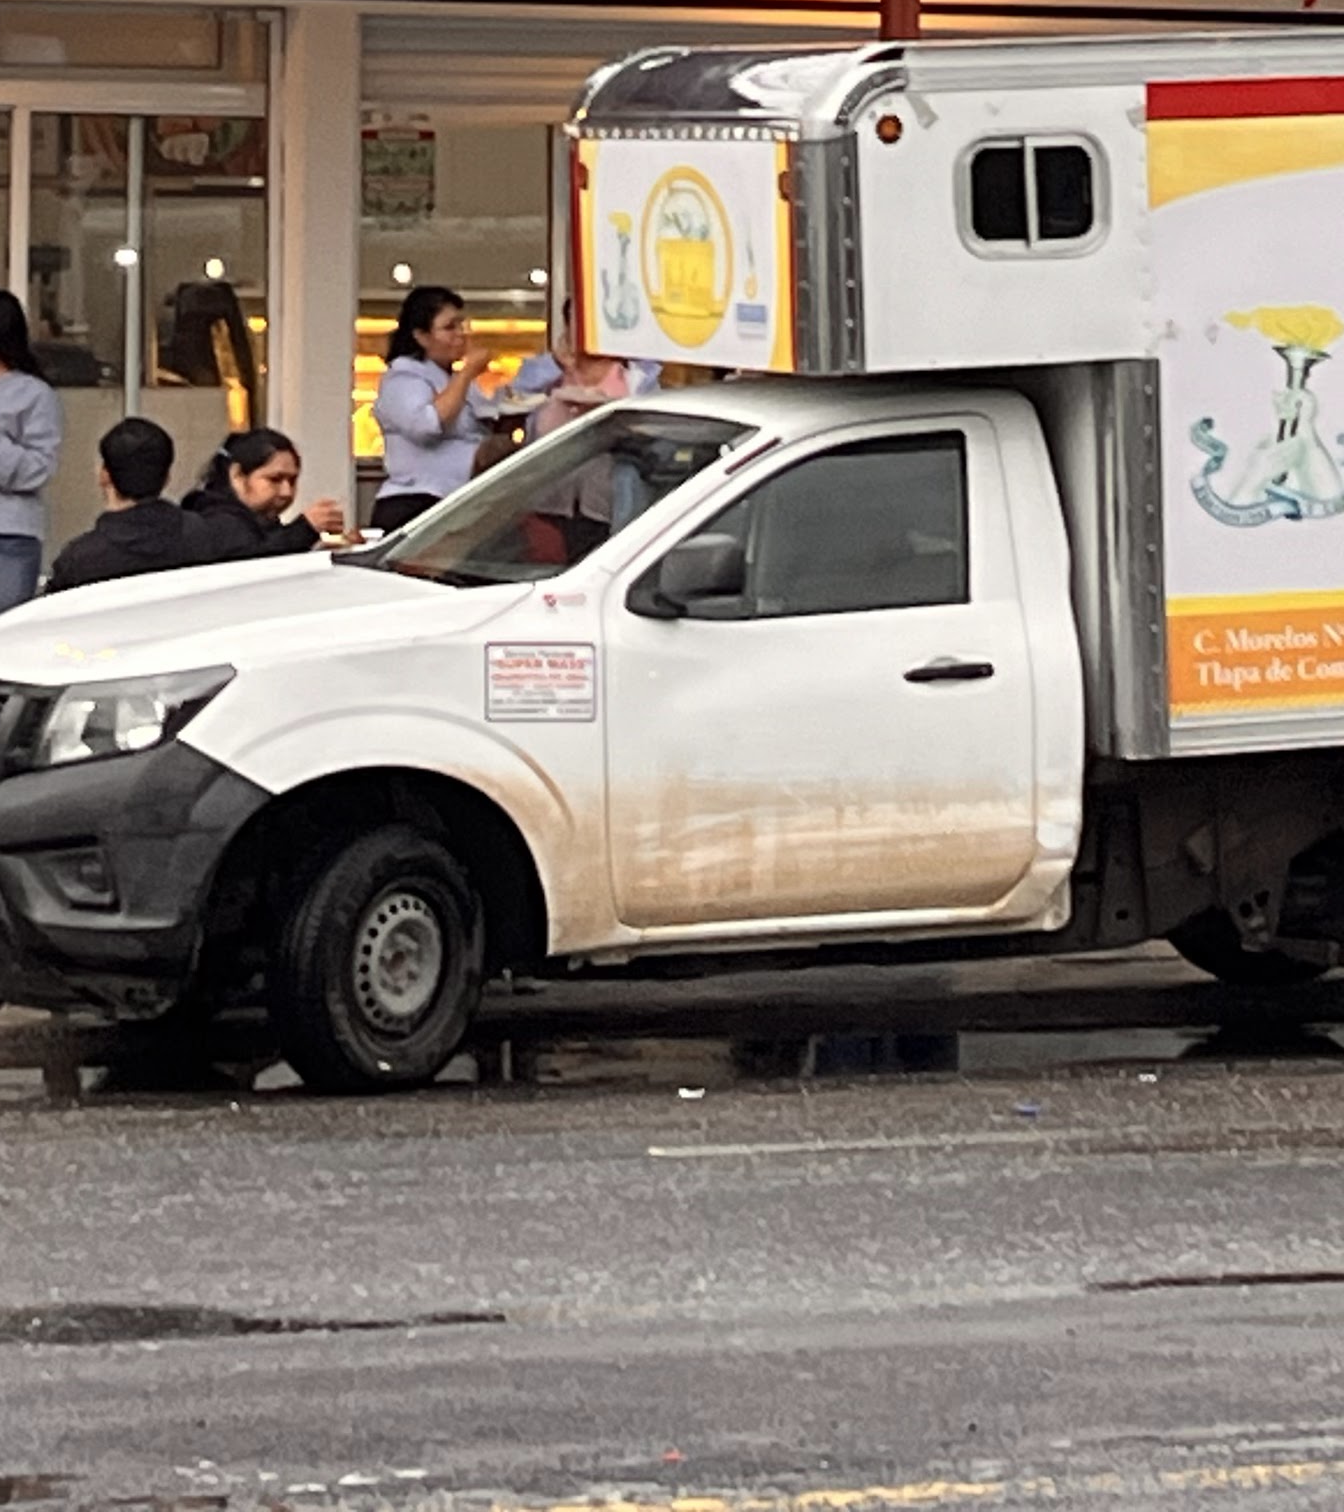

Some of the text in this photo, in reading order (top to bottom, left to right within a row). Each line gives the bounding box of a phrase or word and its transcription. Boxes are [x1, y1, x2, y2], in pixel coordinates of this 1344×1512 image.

[1225, 625, 1318, 654] Morelos
[1194, 660, 1261, 692] Tlapa
[1264, 657, 1292, 683] de
